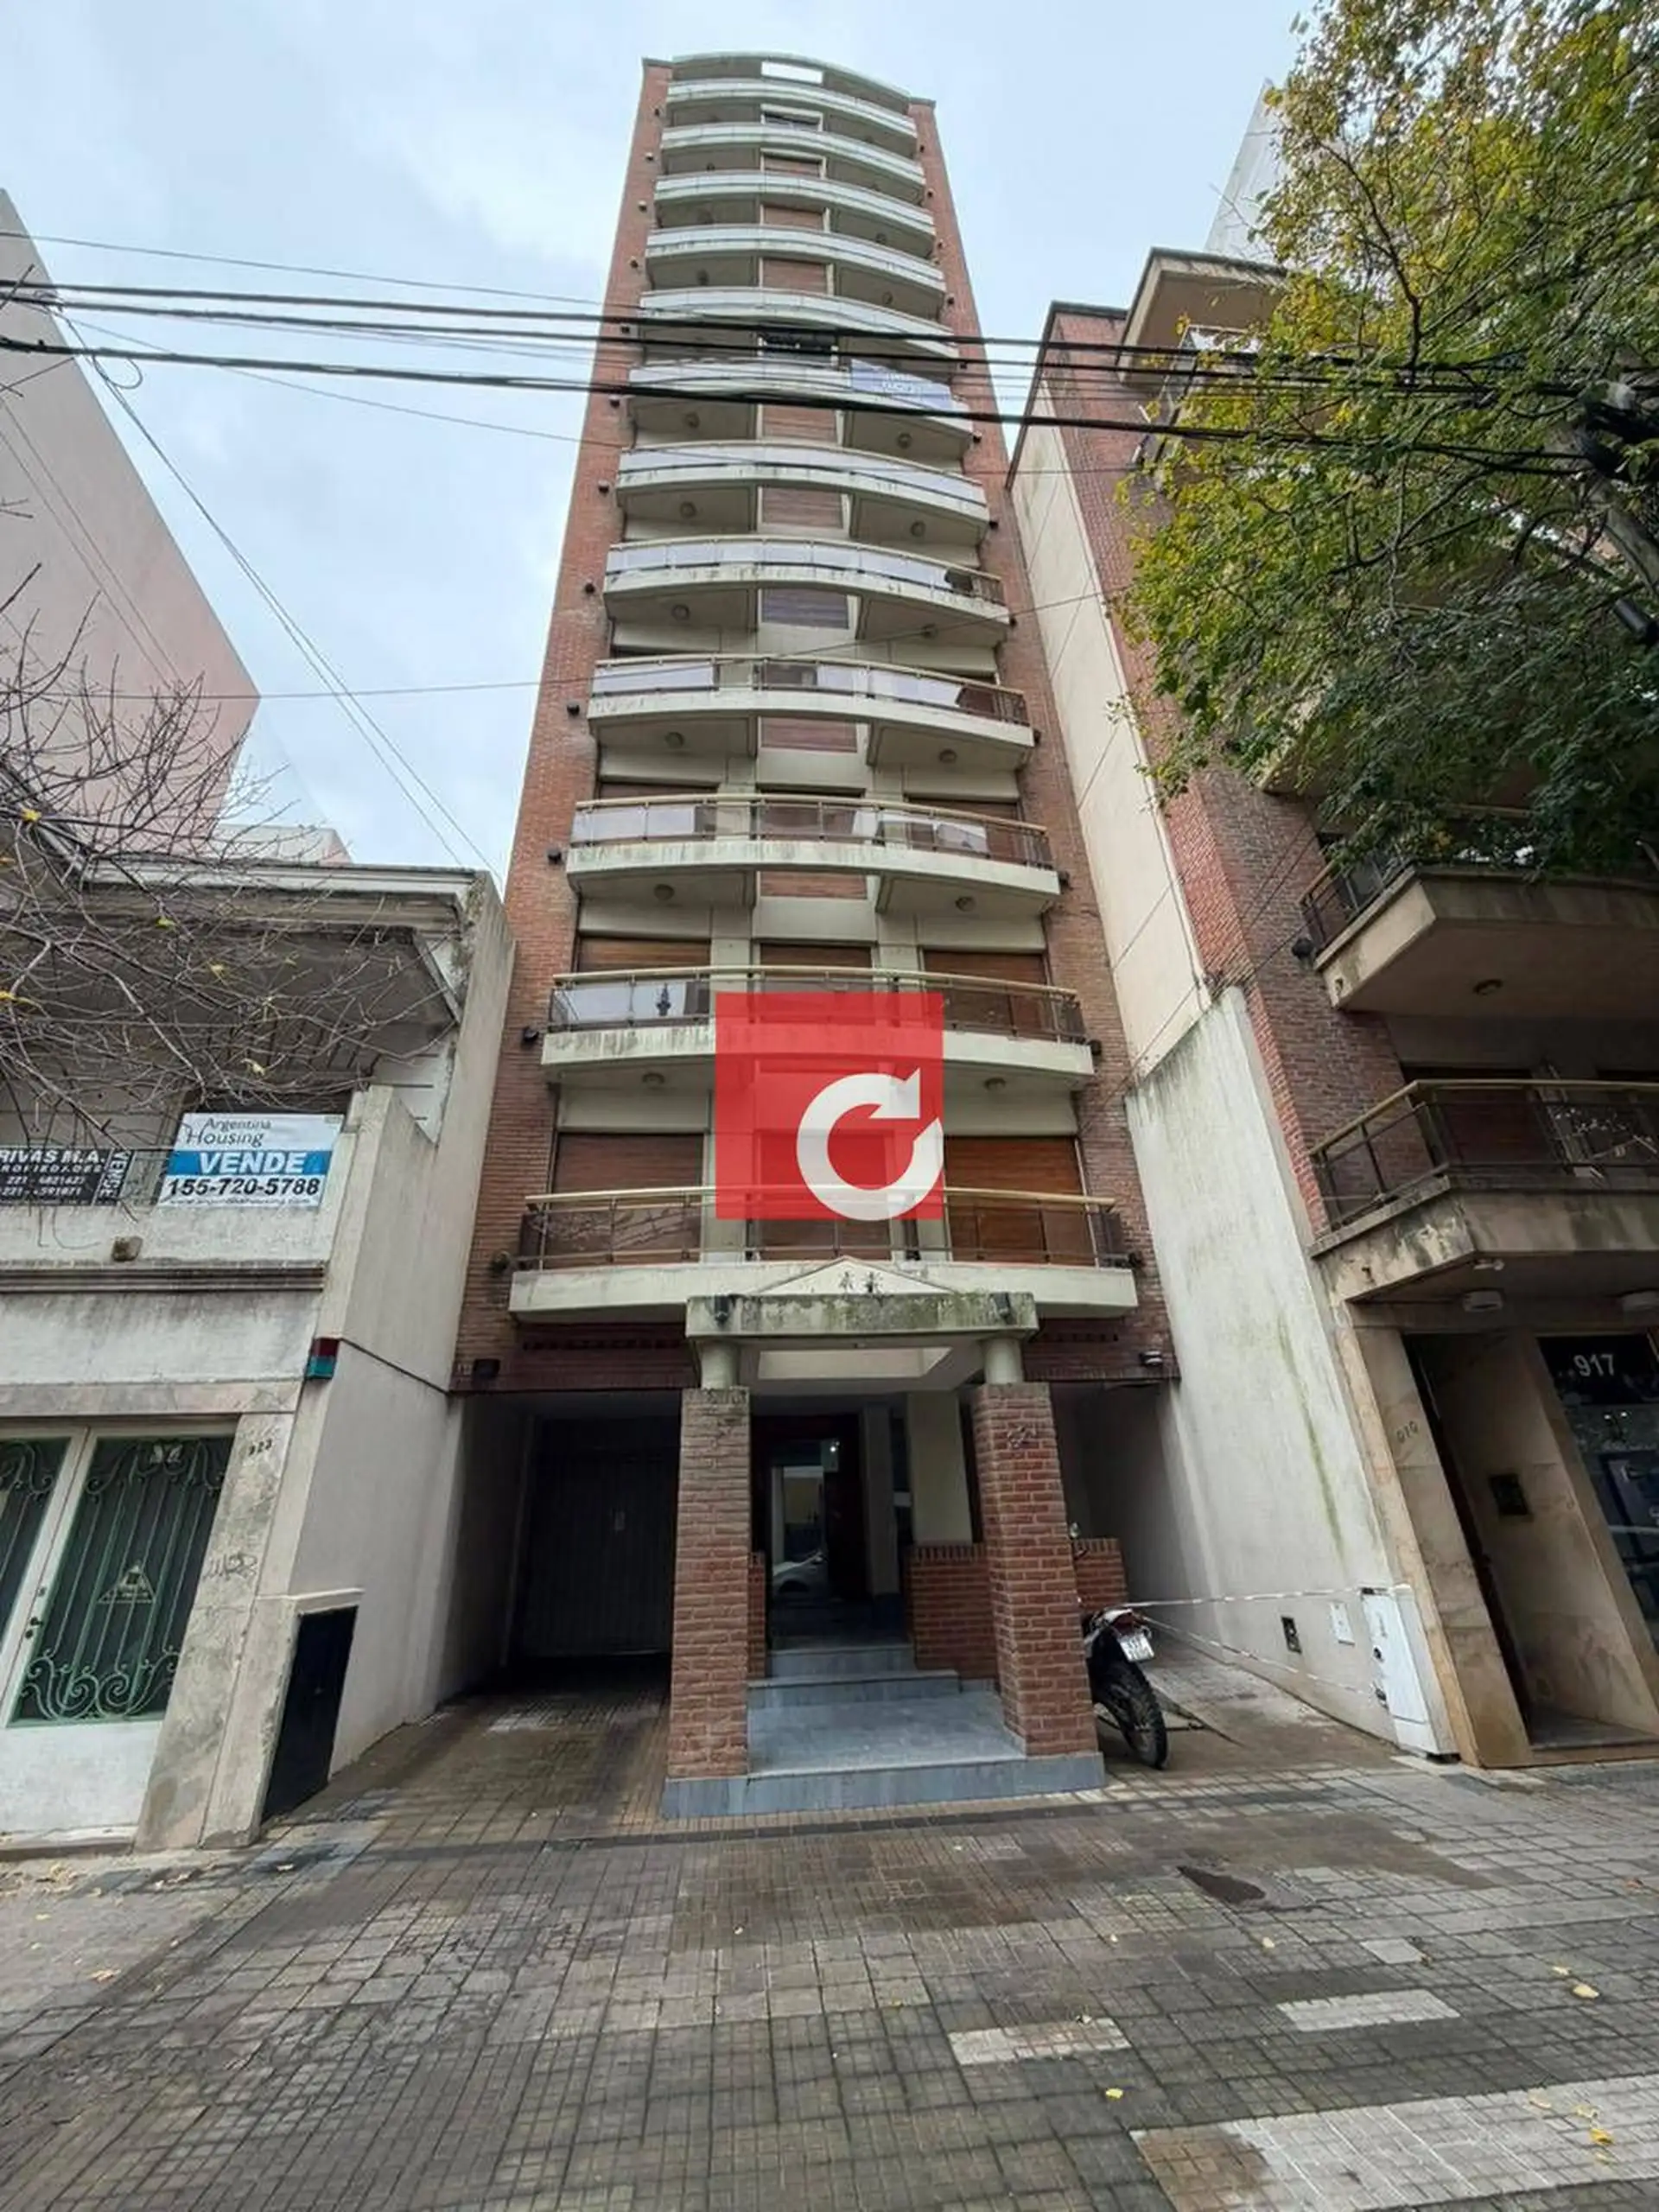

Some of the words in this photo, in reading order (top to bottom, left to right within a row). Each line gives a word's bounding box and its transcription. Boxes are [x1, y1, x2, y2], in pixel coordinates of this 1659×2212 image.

[205, 1118, 272, 1132] Argentina
[183, 1126, 264, 1147] Housing
[199, 1151, 308, 1174] VENDE
[168, 1178, 321, 1197] 155-720-5788
[1573, 1354, 1613, 1376] 917
